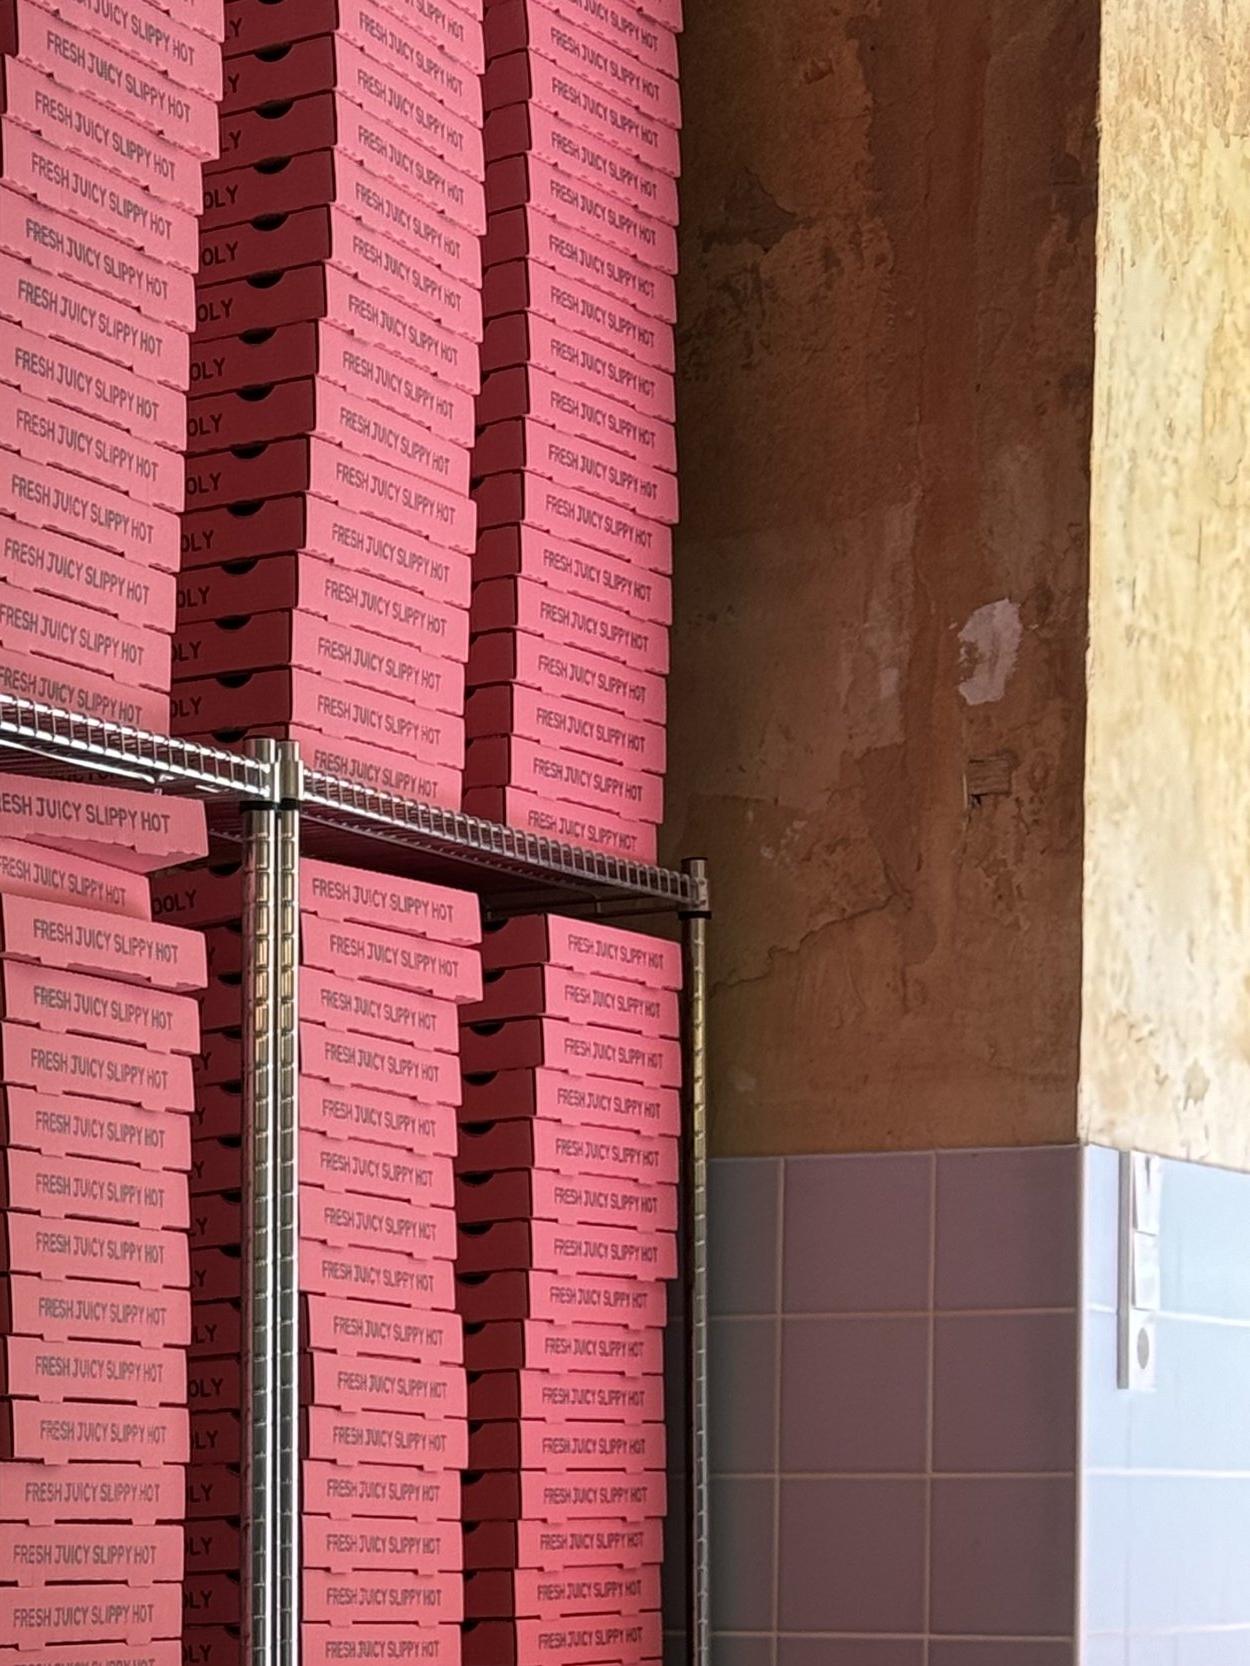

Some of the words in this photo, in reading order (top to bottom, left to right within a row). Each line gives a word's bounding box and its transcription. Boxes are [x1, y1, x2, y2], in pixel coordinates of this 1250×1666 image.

[31, 151, 70, 190] FRESH
[71, 171, 107, 209] JUICY
[108, 189, 149, 229] SLIPPY
[149, 212, 173, 241] HOT
[17, 277, 58, 314] FRESH
[59, 295, 97, 330] JUICY
[98, 312, 139, 348] SLIPPY
[139, 329, 164, 359] HOT
[336, 461, 370, 492] FRESH
[369, 474, 401, 504] JUICY
[401, 486, 435, 518] SLIPPY
[435, 501, 457, 526] HOT
[4, 536, 45, 570] FRESH
[46, 550, 84, 584] JUICY
[84, 564, 126, 598] SLIPPY
[126, 579, 151, 607] HOT
[317, 636, 353, 664] FRESH
[352, 646, 385, 674] JUICY
[384, 657, 420, 686] SLIPPY
[421, 669, 443, 693] HOT
[537, 653, 568, 680] FRESH
[569, 663, 597, 689] JUICY
[597, 672, 628, 699] SLIPPY
[628, 681, 648, 704] HOT
[35, 796, 82, 823] JUICY
[85, 802, 138, 831] SLIPPY
[140, 810, 172, 835] HOT
[311, 876, 351, 903] FRESH
[352, 885, 388, 910] JUICY
[389, 892, 430, 918] SLIPPY
[431, 901, 455, 922] HOT
[567, 932, 595, 956] FRESH
[595, 939, 619, 961] JUICY
[619, 945, 647, 968] SLIPPY
[648, 950, 665, 970] HOT
[30, 1047, 69, 1075] FRESH
[70, 1053, 105, 1080] JUICY
[106, 1060, 145, 1087] SLIPPY
[146, 1067, 170, 1090] HOT
[13, 1543, 53, 1566] FRESH
[54, 1543, 91, 1566] JUICY
[92, 1544, 133, 1565] SLIPPY
[133, 1544, 158, 1565] HOT
